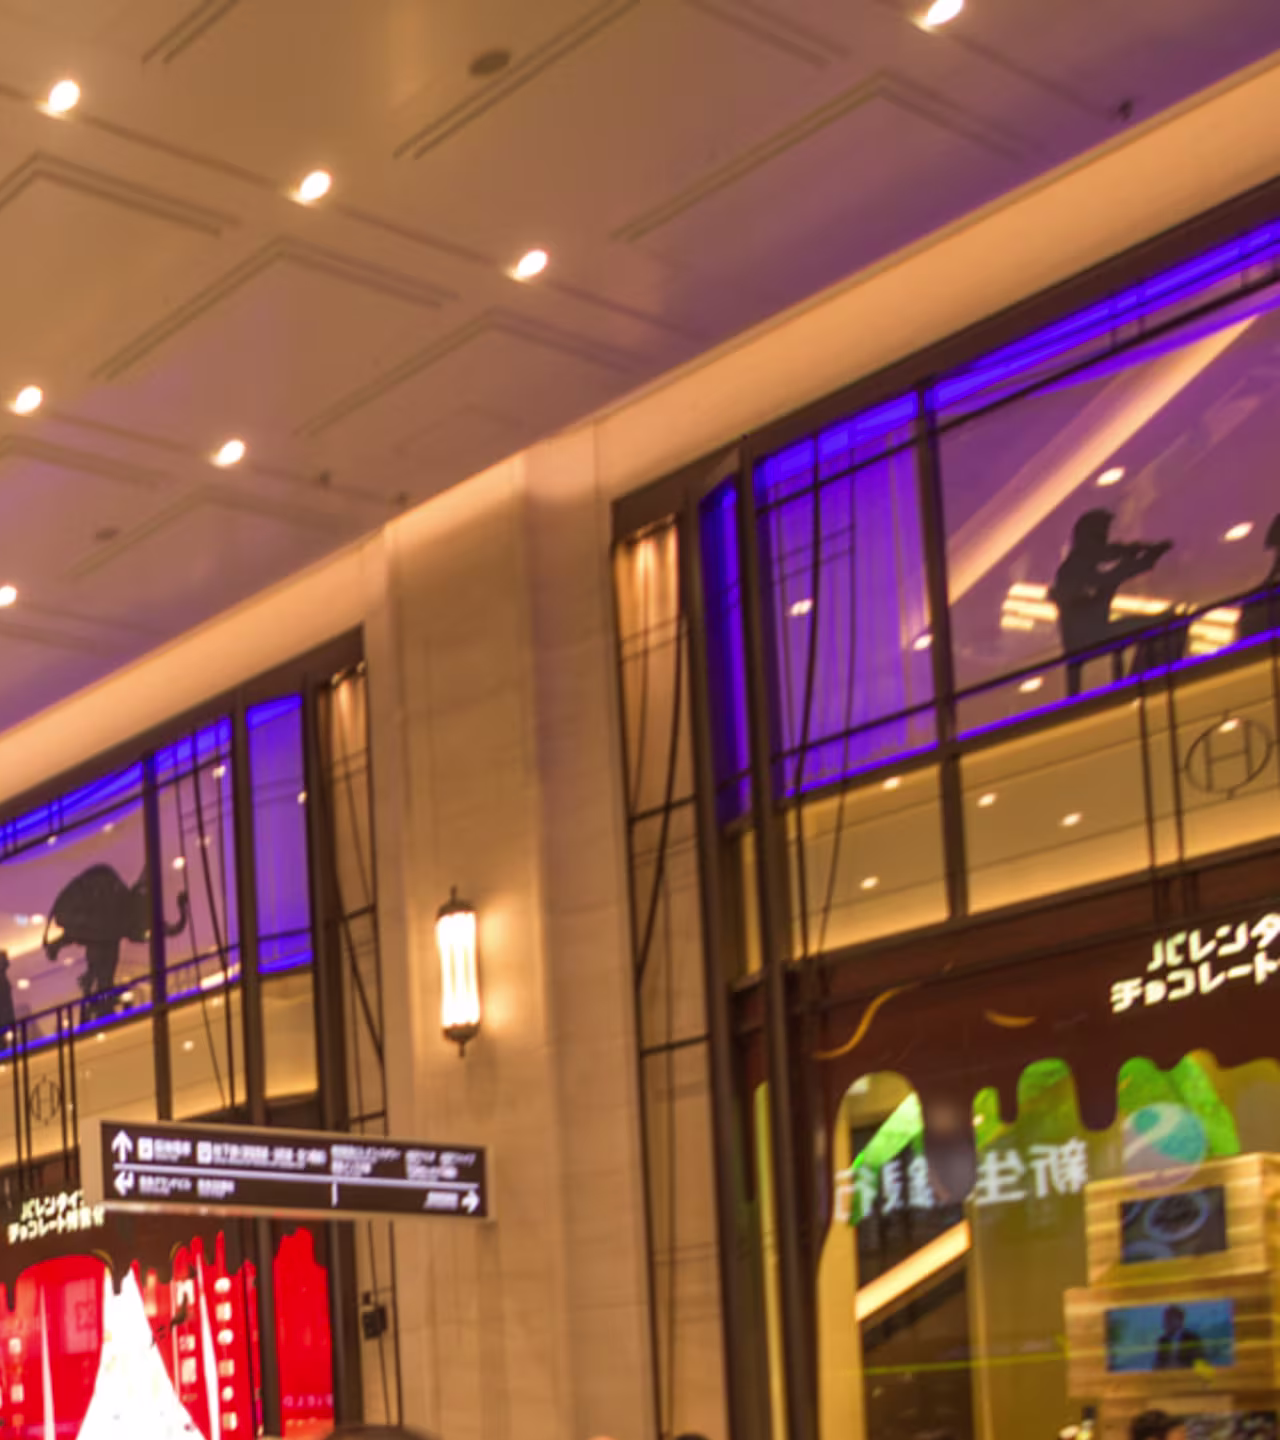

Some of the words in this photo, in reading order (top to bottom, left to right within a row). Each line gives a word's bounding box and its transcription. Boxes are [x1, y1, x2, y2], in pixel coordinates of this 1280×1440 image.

[1110, 950, 1279, 1013] チョコレート
